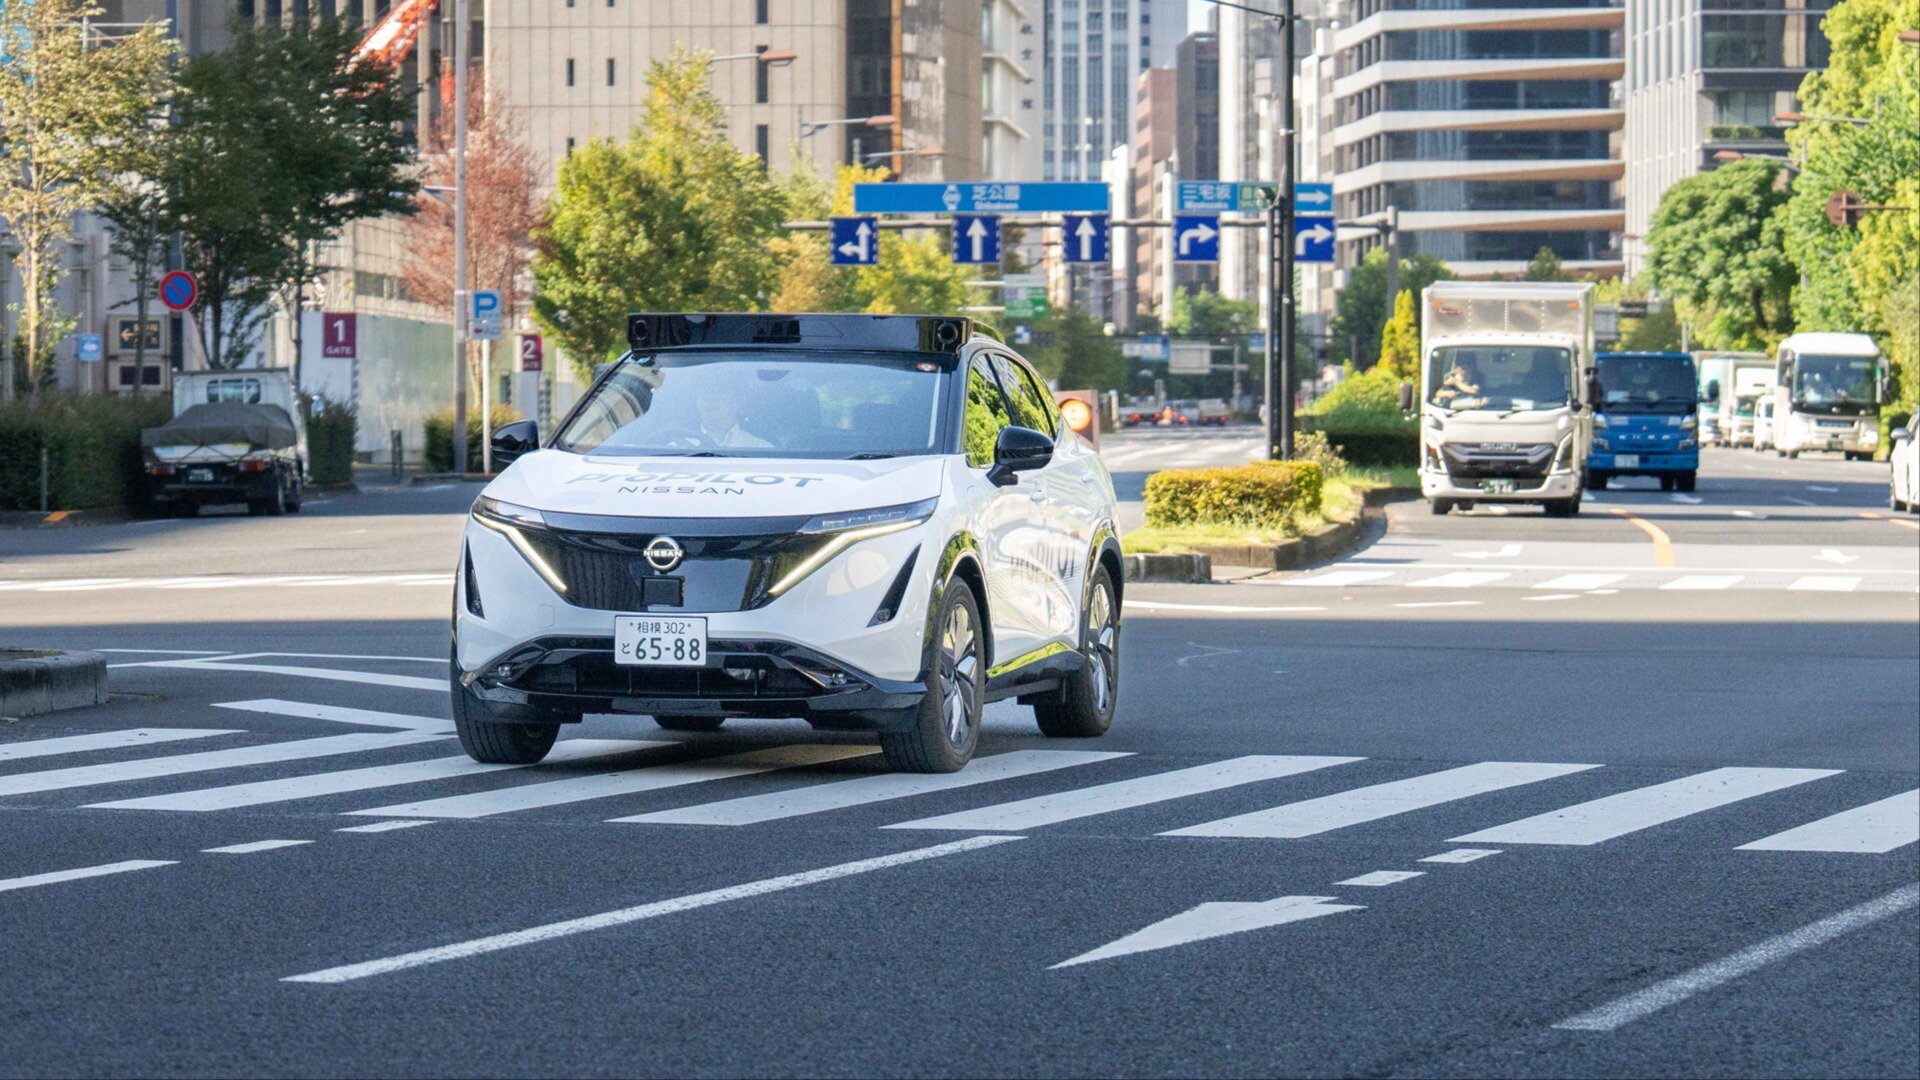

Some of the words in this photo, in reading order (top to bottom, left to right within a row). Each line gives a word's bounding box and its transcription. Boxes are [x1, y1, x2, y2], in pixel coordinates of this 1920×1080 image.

[1182, 184, 1231, 200] 三宅坂
[473, 292, 498, 319] P
[332, 319, 345, 342] 1
[325, 345, 353, 355] GATE
[523, 339, 537, 360] 2
[617, 486, 744, 495] NISSAN
[643, 548, 683, 558] NISSAN
[621, 642, 630, 655] と
[635, 637, 701, 661] 65-88
